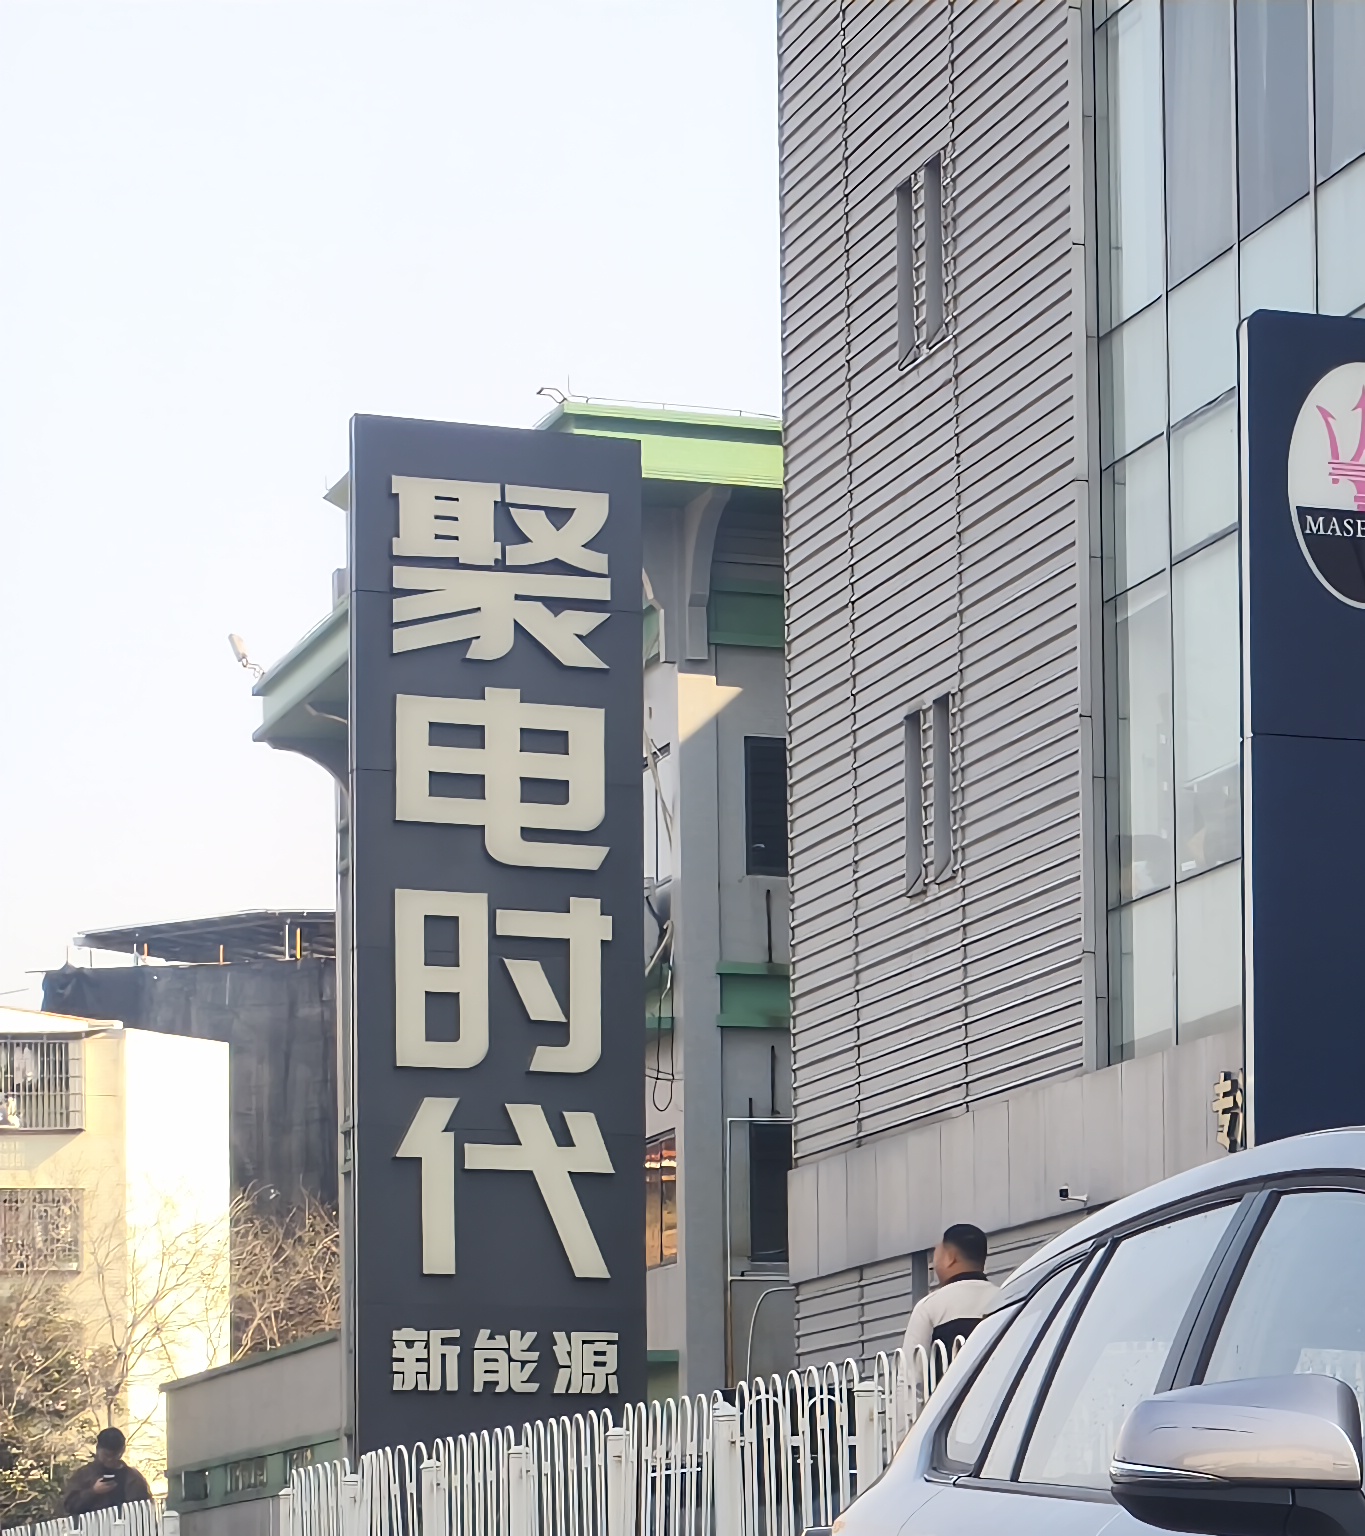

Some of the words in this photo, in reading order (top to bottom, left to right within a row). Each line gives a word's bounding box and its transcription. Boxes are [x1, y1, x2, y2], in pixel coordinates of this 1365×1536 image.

[390, 475, 615, 1280] 聚电时代
[390, 1326, 620, 1396] 新能源
